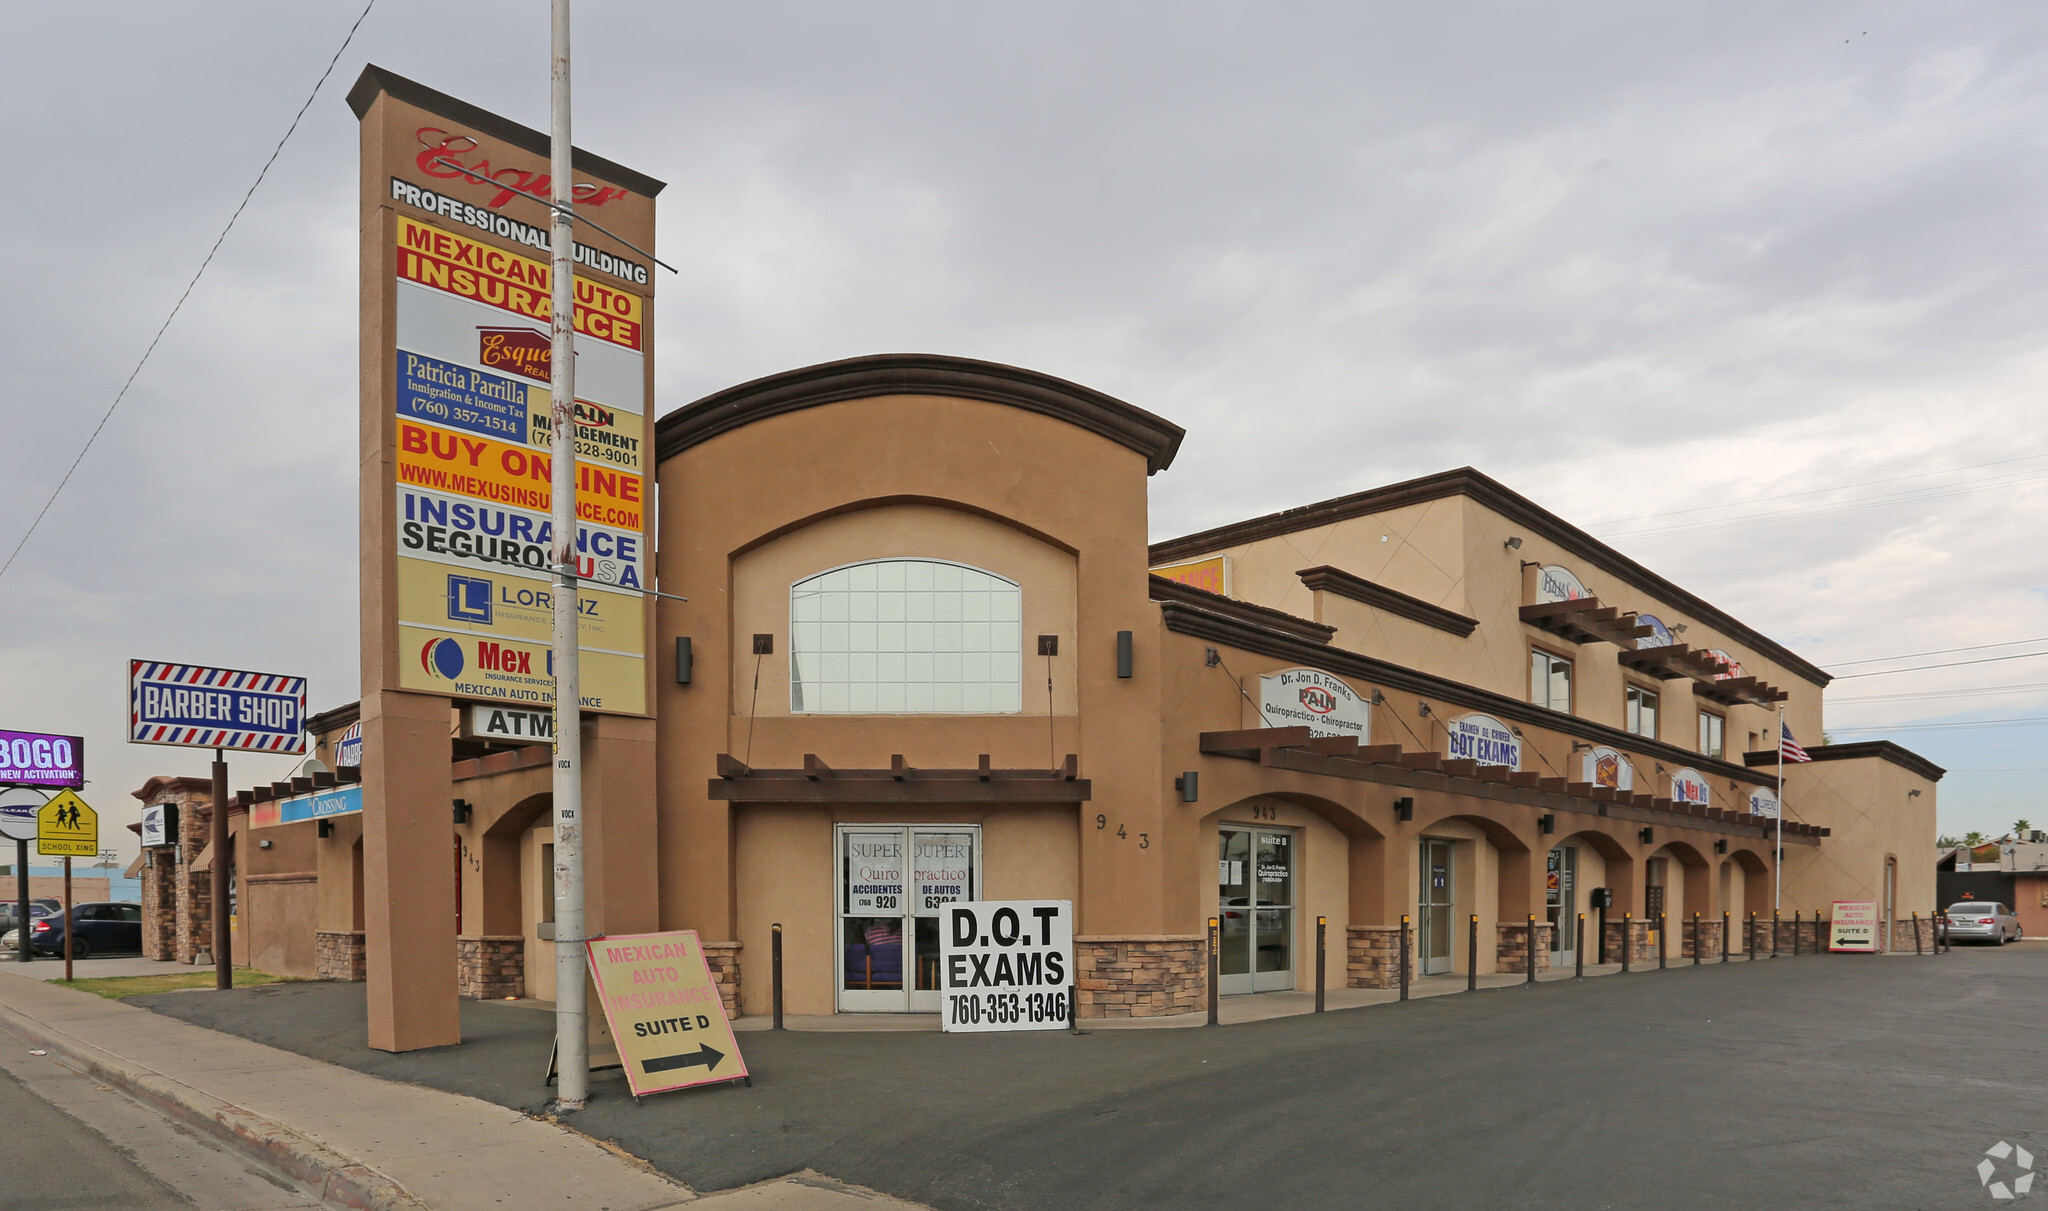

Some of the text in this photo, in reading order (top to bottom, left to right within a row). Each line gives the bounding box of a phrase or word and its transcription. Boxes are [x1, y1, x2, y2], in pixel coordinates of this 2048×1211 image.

[392, 179, 648, 285] PROFESSIONAL UILDING
[406, 224, 631, 316] MEXICAN UTO
[483, 335, 551, 366] Esque
[406, 354, 525, 405] Patricia Parrilla
[524, 365, 550, 379] REAL
[408, 379, 524, 418] Inmigration & Income Tax
[412, 396, 517, 434] (760) 357-1514
[574, 403, 614, 427] AIN
[402, 424, 640, 503] BUY ONINE
[574, 441, 637, 466] 328-9001
[400, 462, 639, 529] WWW.MEXUSINSUNCE.COM
[402, 521, 640, 589] SEGURO USA
[458, 584, 484, 616] L
[502, 586, 598, 616] LORNZ
[495, 610, 548, 624] INSURANCE
[478, 641, 532, 674] Mex
[455, 682, 506, 697] MEXICAN
[510, 688, 538, 700] AUTO
[485, 673, 522, 683] INSURANCE
[1281, 672, 1352, 701] Dr. Jon D. Franks
[145, 686, 294, 730] BARBER SHOP
[1299, 688, 1336, 710] PAIN
[487, 710, 554, 738] ATM
[1266, 703, 1315, 722] Quiropráctico
[1322, 716, 1363, 731] Chiropractor
[1460, 722, 1510, 742] EXAMEN DE CHOFER
[0, 738, 73, 769] BOGO
[1450, 730, 1517, 766] DOT EXAMS
[0, 770, 20, 779] NEW
[1686, 780, 1698, 801] Mex
[312, 796, 347, 816] CROSSING
[1254, 806, 1276, 820] 943
[1096, 814, 1149, 849] 943
[1261, 836, 1287, 846] suite B
[463, 845, 480, 872] 943
[852, 844, 902, 858] SUPER
[860, 866, 966, 882] Quiro practico
[852, 885, 961, 895] ACCIDENTES DE AUTOS
[876, 896, 896, 908] 920
[952, 907, 1059, 948] D.O.T
[606, 942, 688, 964] MEXICAN
[633, 966, 679, 985] AUTO
[948, 952, 1065, 988] EXAMS
[610, 986, 713, 1012] INSURANCE
[950, 992, 1066, 1024] 760-353-1346
[634, 1014, 710, 1038] SUITE D
